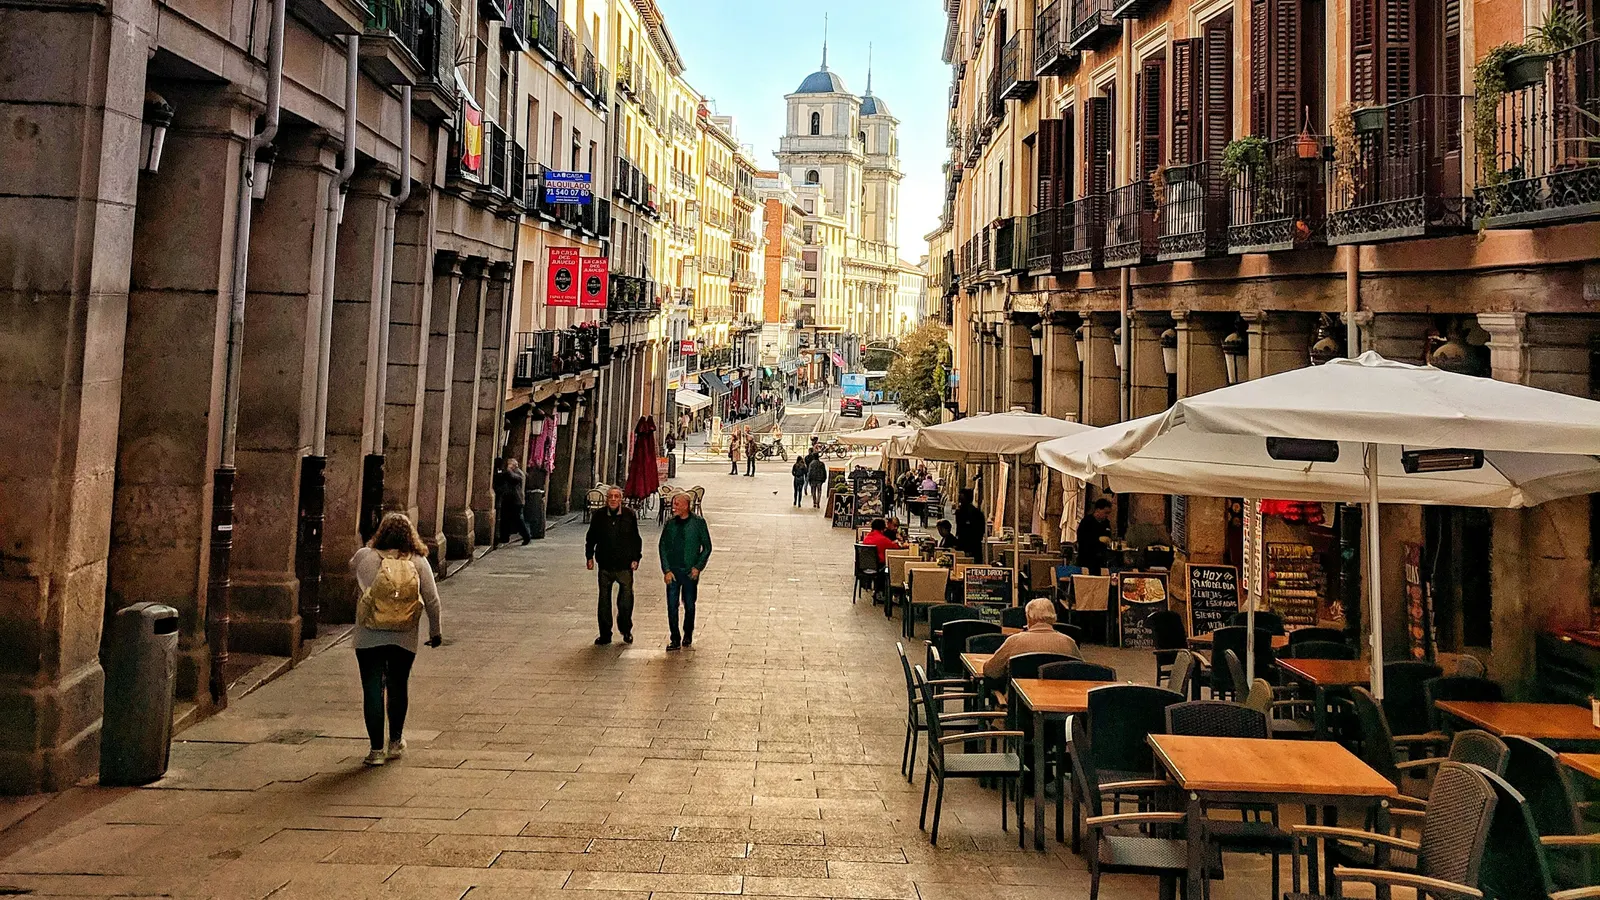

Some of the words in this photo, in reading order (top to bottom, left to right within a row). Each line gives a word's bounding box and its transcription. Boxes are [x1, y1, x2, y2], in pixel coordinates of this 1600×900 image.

[547, 181, 591, 190] ALQUILADO
[546, 188, 555, 196] 91
[1202, 569, 1223, 581] HOY
[1191, 579, 1212, 589] PLATO
[1212, 581, 1223, 589] DEL
